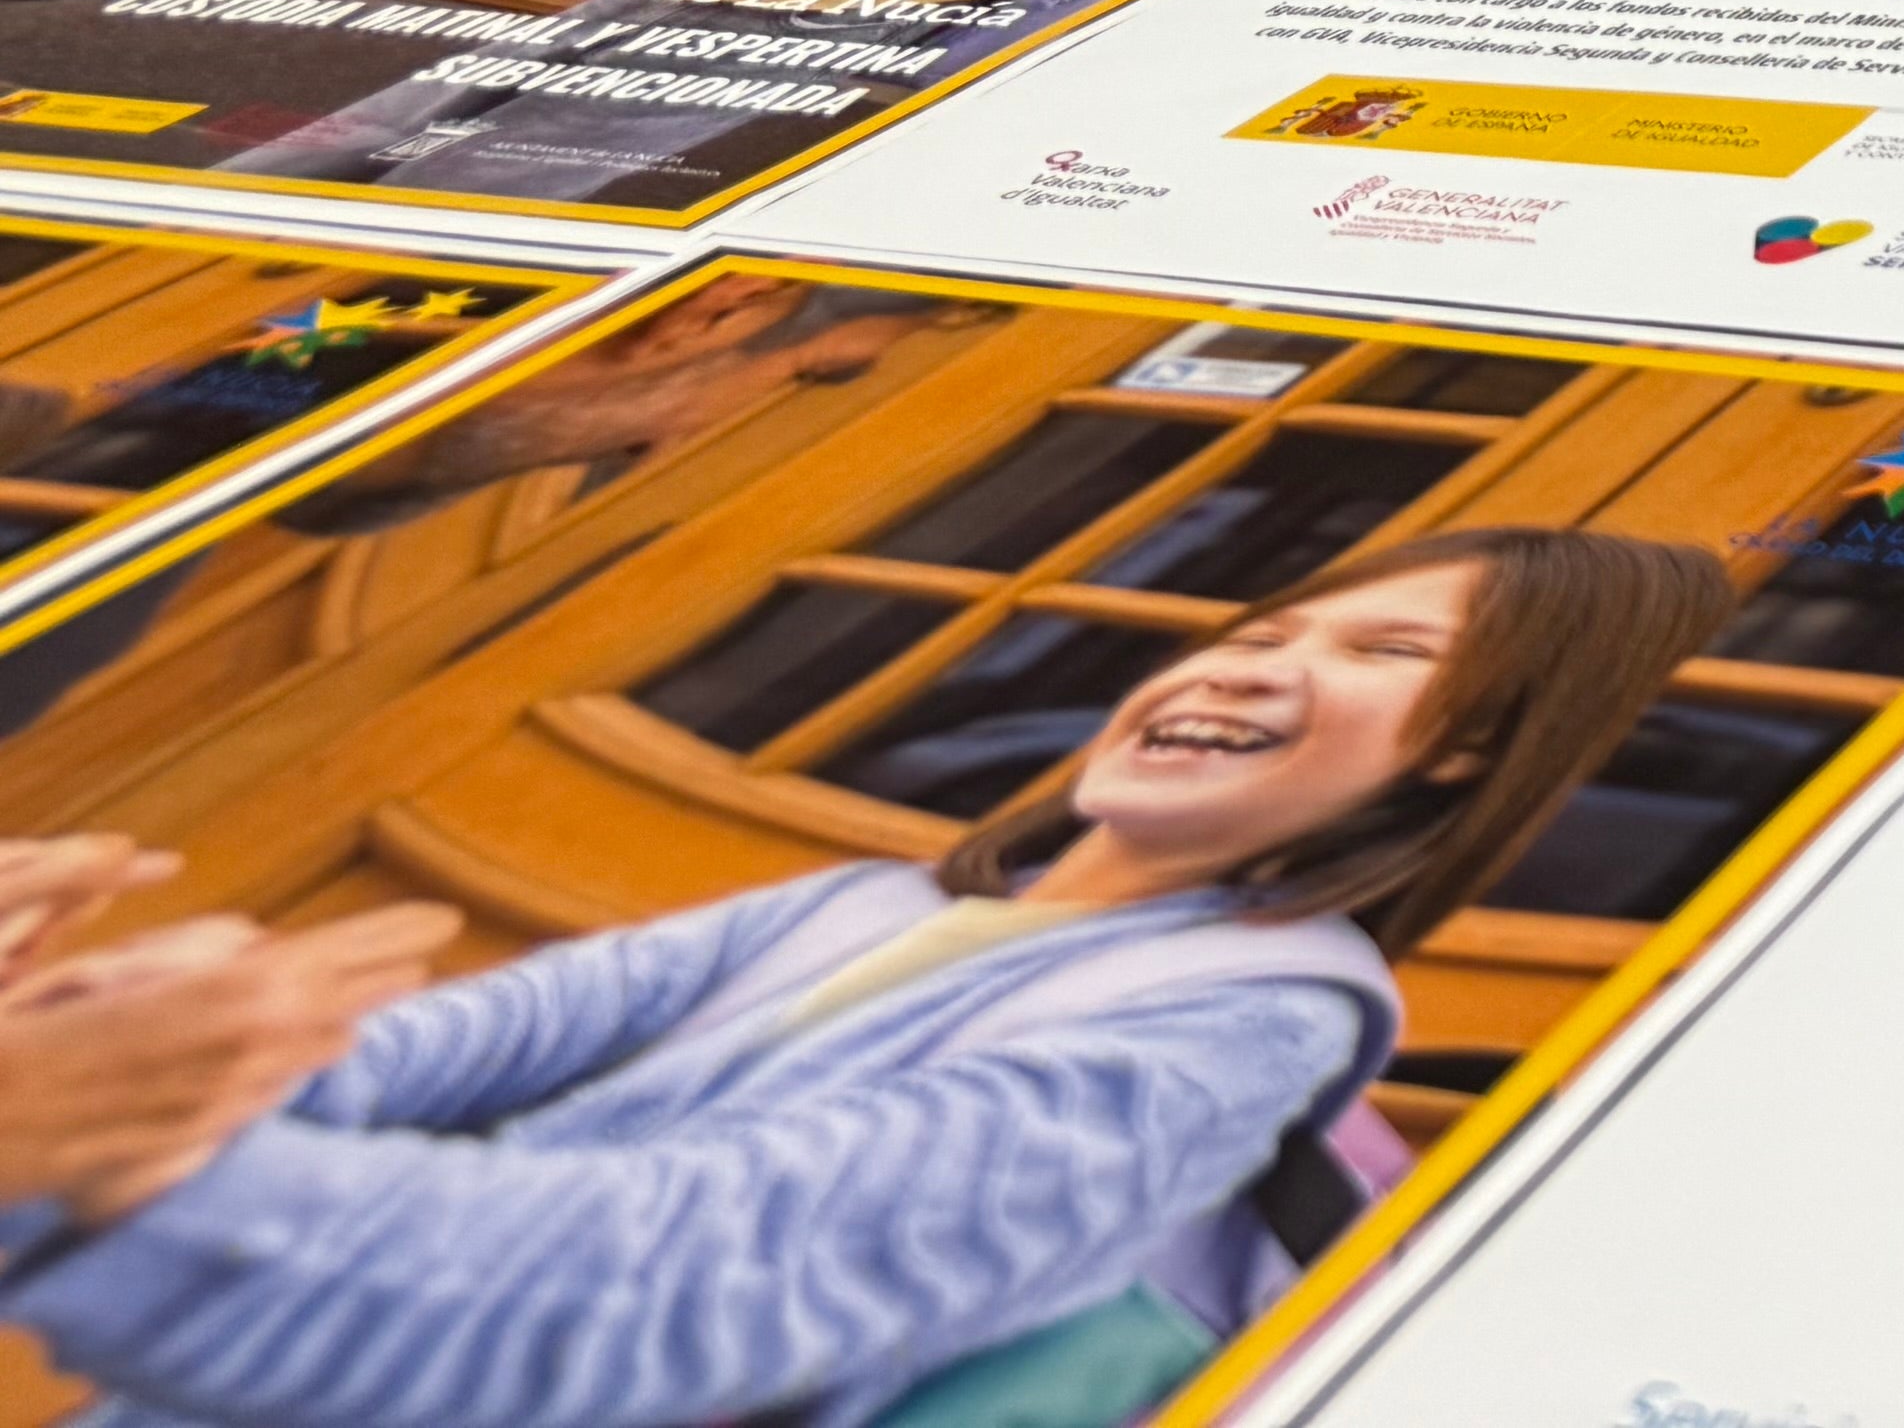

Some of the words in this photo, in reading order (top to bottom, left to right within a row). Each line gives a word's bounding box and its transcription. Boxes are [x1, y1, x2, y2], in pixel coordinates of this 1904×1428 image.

[1605, 0, 1692, 17] fondos
[1690, 5, 1804, 23] recibidos
[1803, 10, 1851, 25] del
[344, 3, 585, 45] MATINAL
[574, 21, 641, 49] Y
[617, 26, 950, 76] VESPERTINA
[411, 53, 871, 117] SUBVENCIONADA
[1372, 198, 1540, 225] VALENCIANA
[1387, 186, 1569, 211] GENERALITAT
